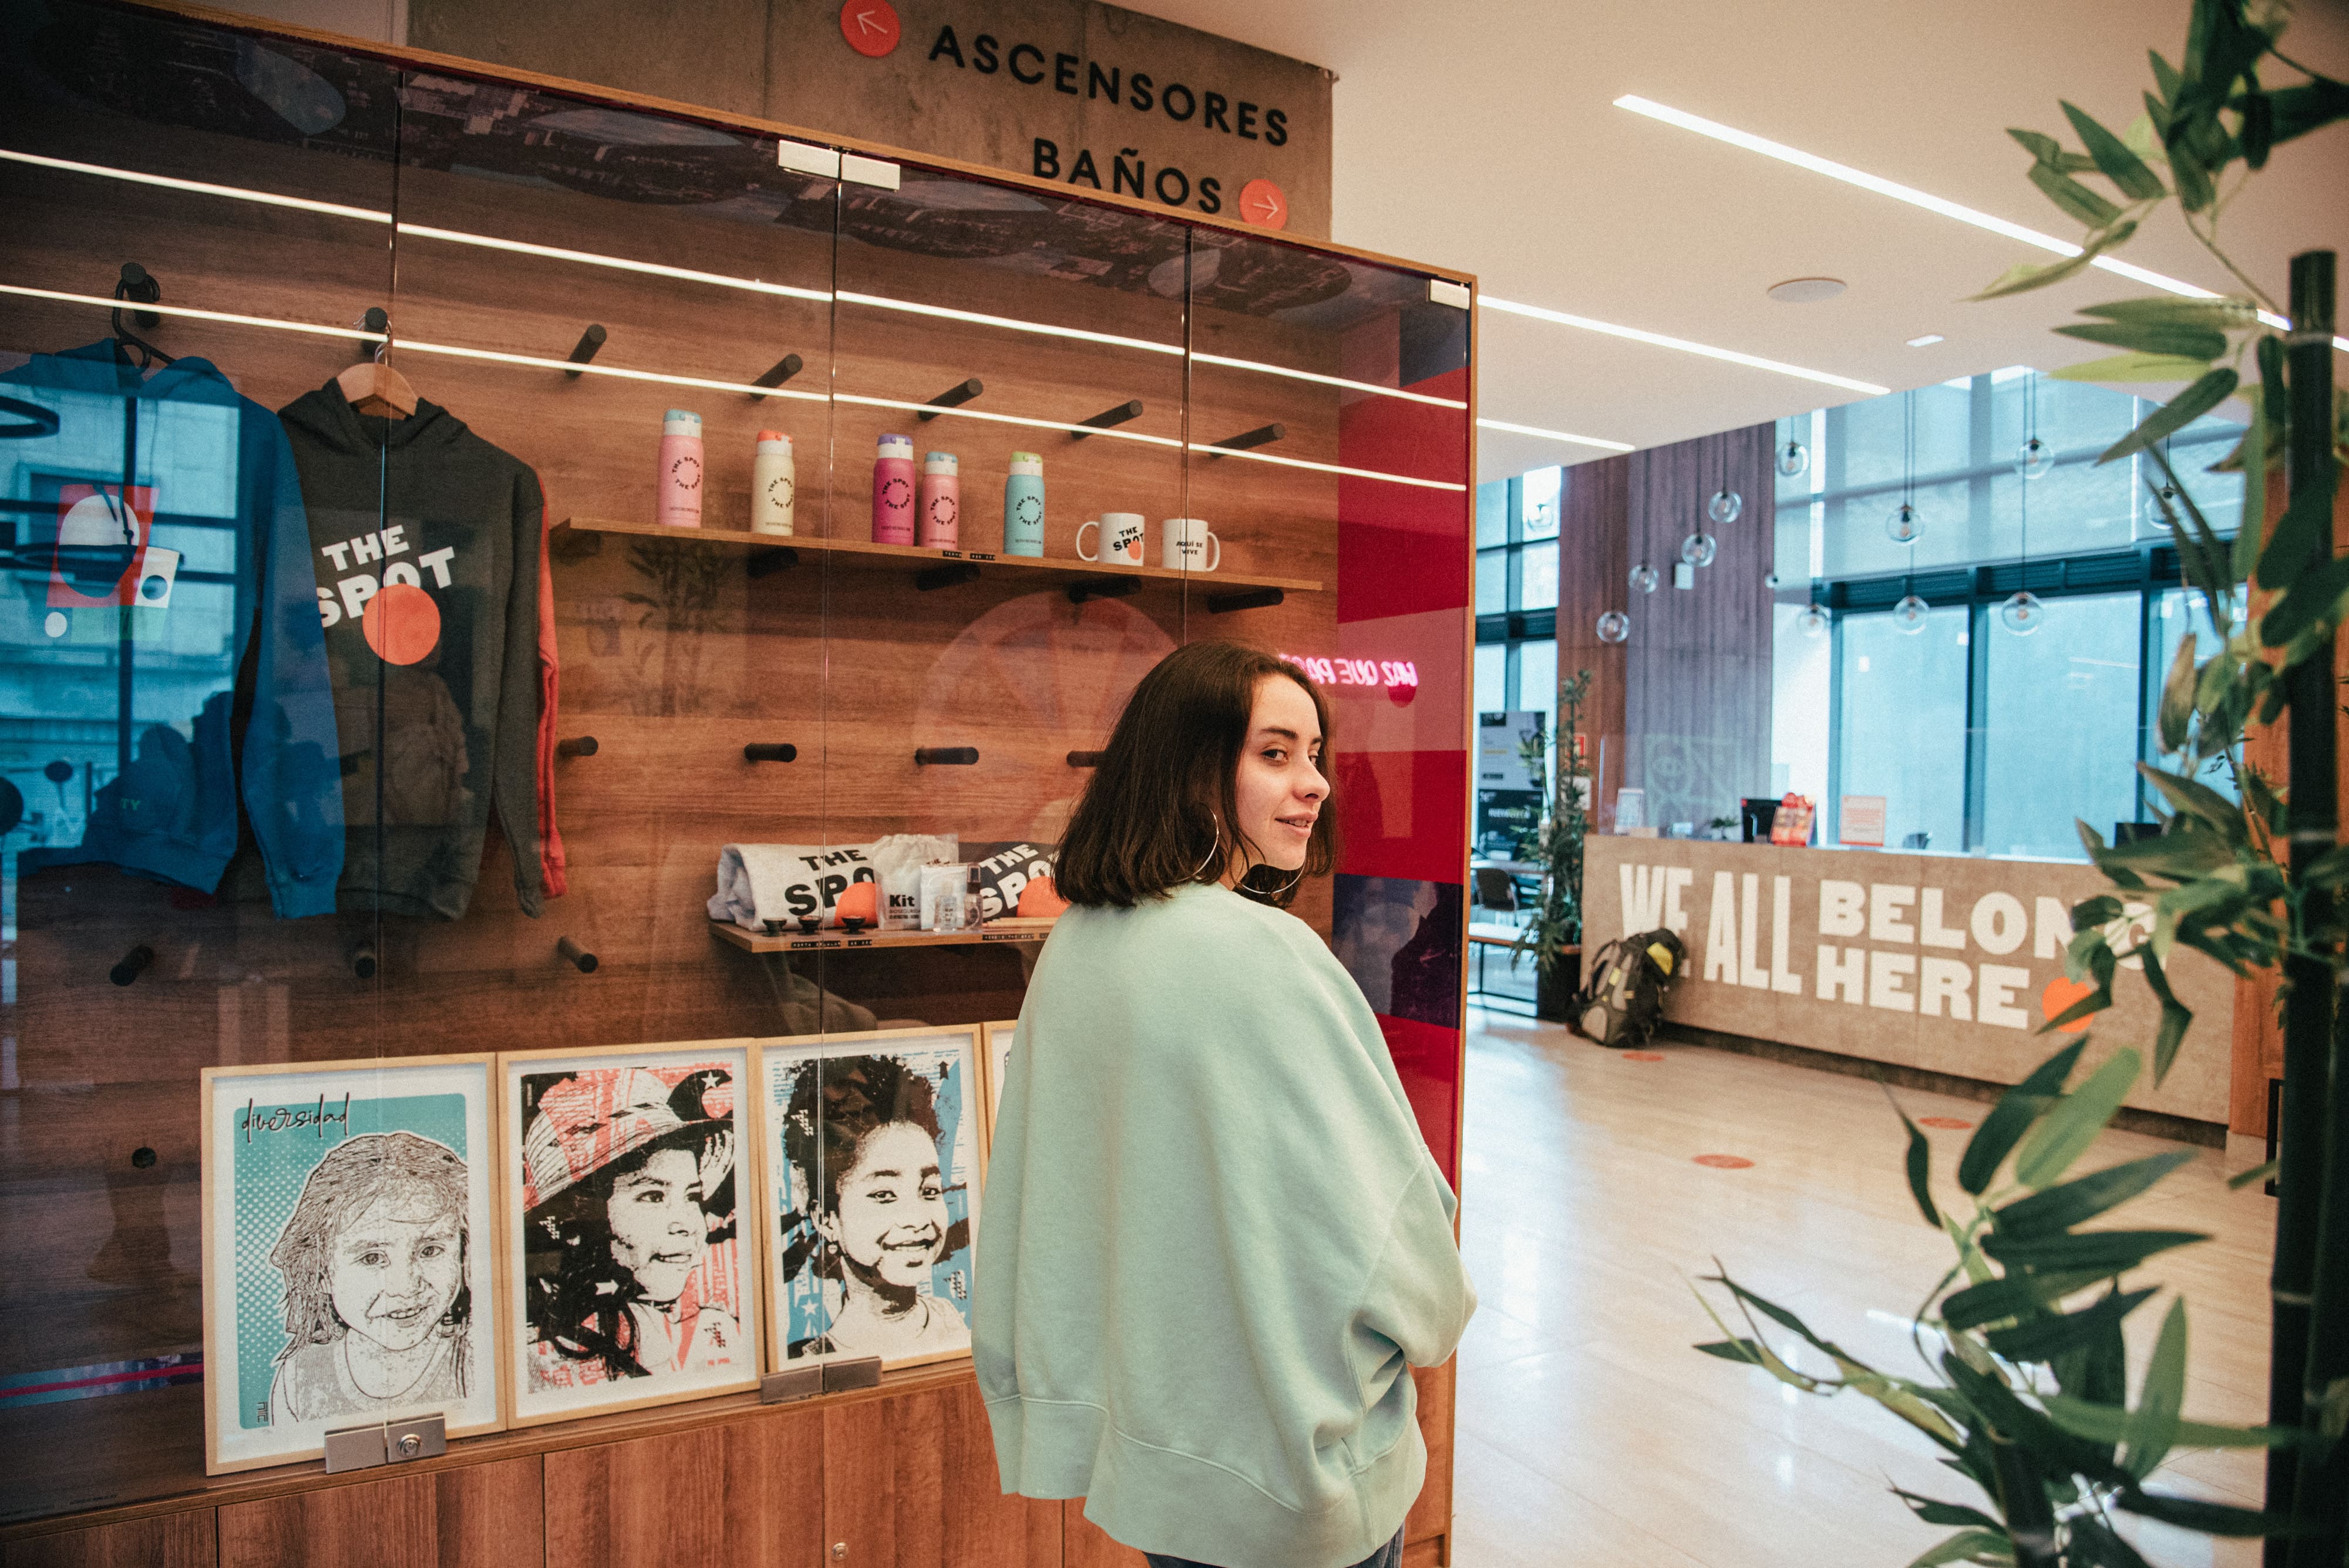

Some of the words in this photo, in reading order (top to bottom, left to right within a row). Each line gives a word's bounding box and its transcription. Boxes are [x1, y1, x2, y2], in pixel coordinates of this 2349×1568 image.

[928, 24, 1288, 147] ASCENSORES
[1033, 137, 1221, 214] BAÑOS
[322, 524, 410, 566] THE
[1112, 533, 1144, 551] SPOT
[1119, 526, 1138, 537] THE
[317, 546, 455, 628] SPOT
[798, 849, 868, 872] THE
[978, 843, 1039, 875] THE
[980, 850, 1059, 918] SPO
[785, 866, 876, 916] SPO
[890, 894, 915, 907] Kit
[1619, 863, 1693, 978] WE
[1703, 870, 1803, 995] ALL
[1819, 879, 2167, 971] BELONG
[1816, 944, 2030, 1030] HERE
[241, 1091, 350, 1143] diversidad
